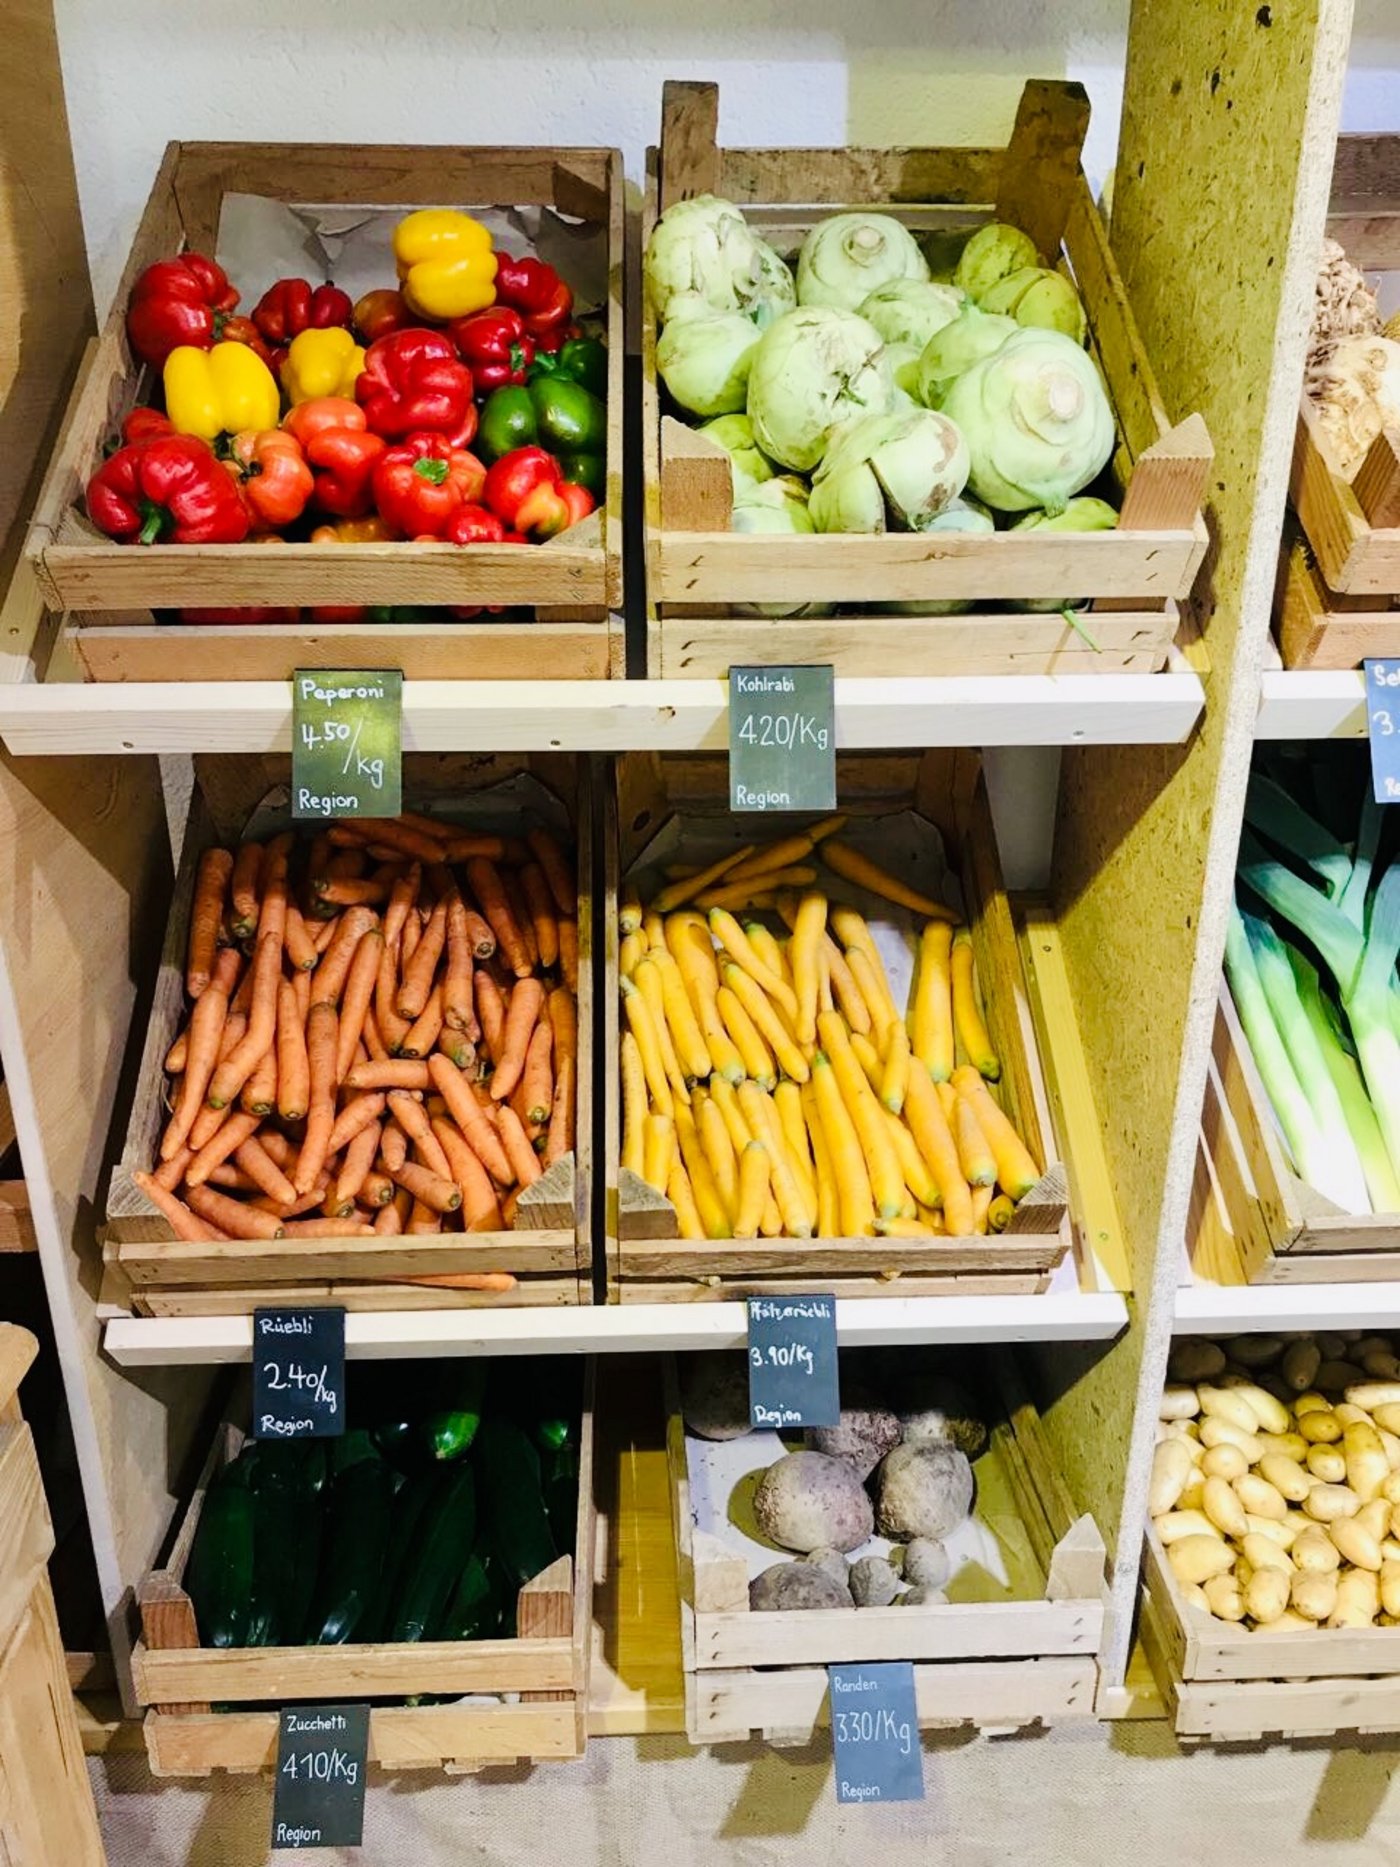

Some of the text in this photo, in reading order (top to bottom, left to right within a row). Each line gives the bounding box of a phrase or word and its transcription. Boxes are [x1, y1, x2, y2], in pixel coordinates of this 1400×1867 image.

[301, 679, 384, 707] Peperoni
[737, 675, 795, 692] Kohlrabi
[299, 788, 358, 816] Region
[736, 784, 790, 809] Region
[260, 1315, 313, 1334] Rüebli
[260, 1414, 314, 1436] Region
[754, 1404, 802, 1428] Region
[834, 1674, 877, 1693] Randen
[287, 1715, 346, 1732] Zucchetti
[841, 1781, 880, 1802] Region
[276, 1822, 321, 1848] Region
